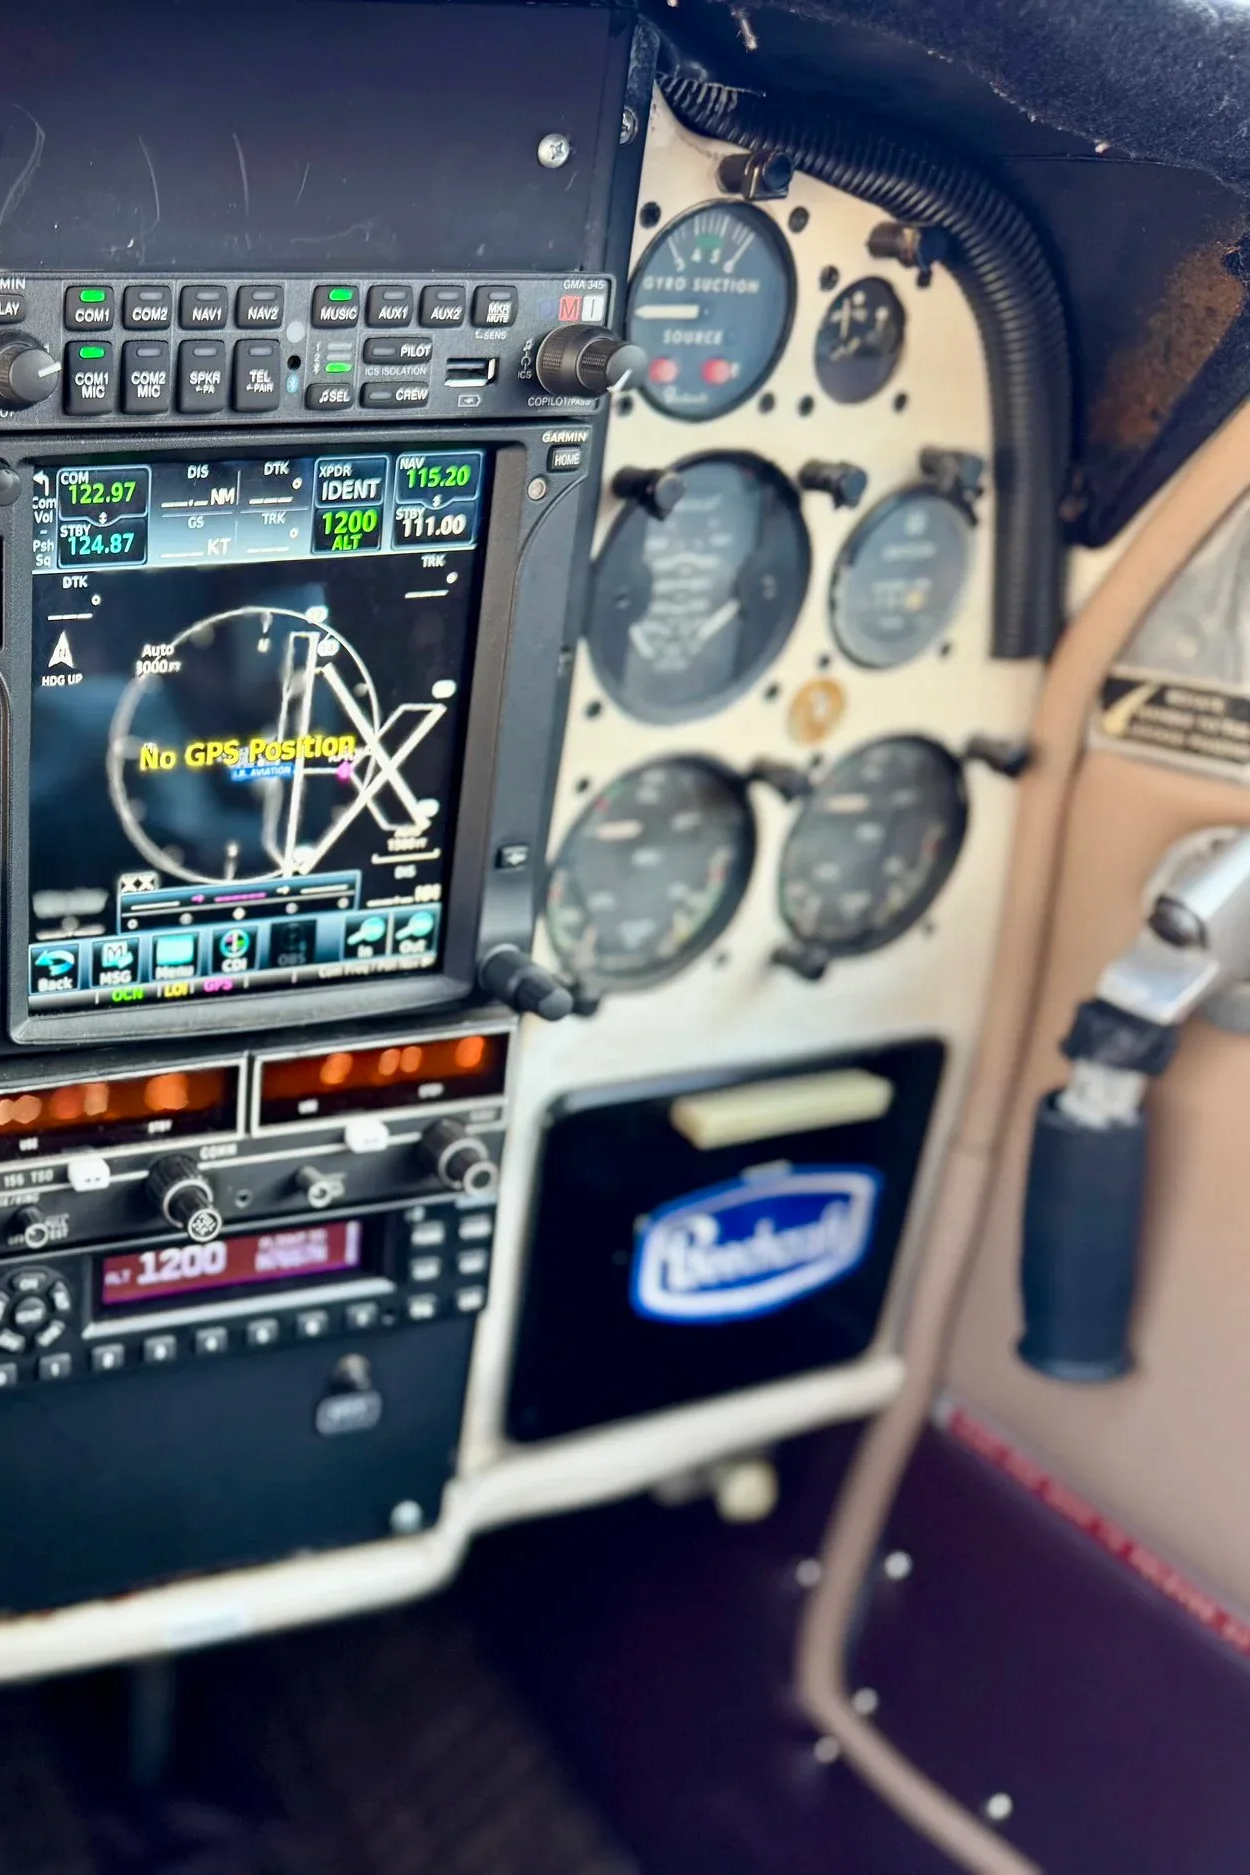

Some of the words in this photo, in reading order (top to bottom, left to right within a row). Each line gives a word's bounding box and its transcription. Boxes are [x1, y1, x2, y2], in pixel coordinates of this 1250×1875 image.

[564, 280, 585, 290] GMA
[587, 280, 604, 290] 345
[642, 275, 686, 291] GYRO
[692, 277, 759, 294] SUCTION
[75, 308, 110, 322] COM1
[132, 307, 168, 321] COM2
[192, 306, 222, 321] NAV1
[247, 306, 279, 320] NAV2
[320, 305, 358, 320] MUSIC
[378, 305, 409, 320] AUX1
[431, 305, 462, 320] AUX2
[488, 302, 512, 314] MKR
[486, 314, 510, 323] MUTE
[483, 331, 506, 340] SENS
[662, 329, 723, 345] SOURCE
[401, 343, 432, 357] PILOT
[131, 371, 166, 385] COM2
[190, 370, 221, 385] SPKR
[249, 369, 270, 383] TEL
[365, 367, 380, 376] ICS
[382, 366, 427, 376] ISOLATION
[75, 372, 109, 385] COM1
[81, 385, 105, 399] MIC
[137, 384, 161, 398] MIC
[253, 384, 274, 393] PAIR
[329, 389, 351, 402] SEL
[395, 387, 428, 401] CREW
[542, 430, 588, 443] GARMIN
[400, 457, 426, 470] NAV
[554, 453, 581, 466] HOME
[187, 465, 209, 479] DIS
[263, 461, 289, 475] DTK
[319, 465, 352, 479] XPDR
[60, 471, 89, 485] COM
[406, 465, 471, 488] 115.20
[69, 481, 136, 505] 122.97
[322, 477, 382, 501] IDENT
[210, 488, 235, 506] NM
[34, 510, 53, 524] Vol
[262, 511, 286, 525] TRK
[396, 507, 425, 521] STBY
[188, 516, 205, 529] GS
[322, 508, 379, 536] 1200
[402, 514, 467, 538] 111.00
[60, 524, 91, 538] STBY
[33, 539, 55, 553] Psh
[68, 532, 134, 556] 124.87
[207, 538, 231, 556] KT
[332, 534, 362, 551] ALT
[36, 554, 52, 567] Sq
[421, 553, 447, 568] TRK
[62, 575, 88, 589] DTK
[141, 644, 174, 658] Auto
[41, 674, 65, 687] HDG
[67, 673, 83, 686] UP
[139, 744, 177, 771] No
[184, 739, 240, 766] GPS
[249, 734, 356, 763] Position
[38, 976, 73, 992] Back
[100, 970, 132, 985] MSG
[137, 1241, 226, 1285] 1200
